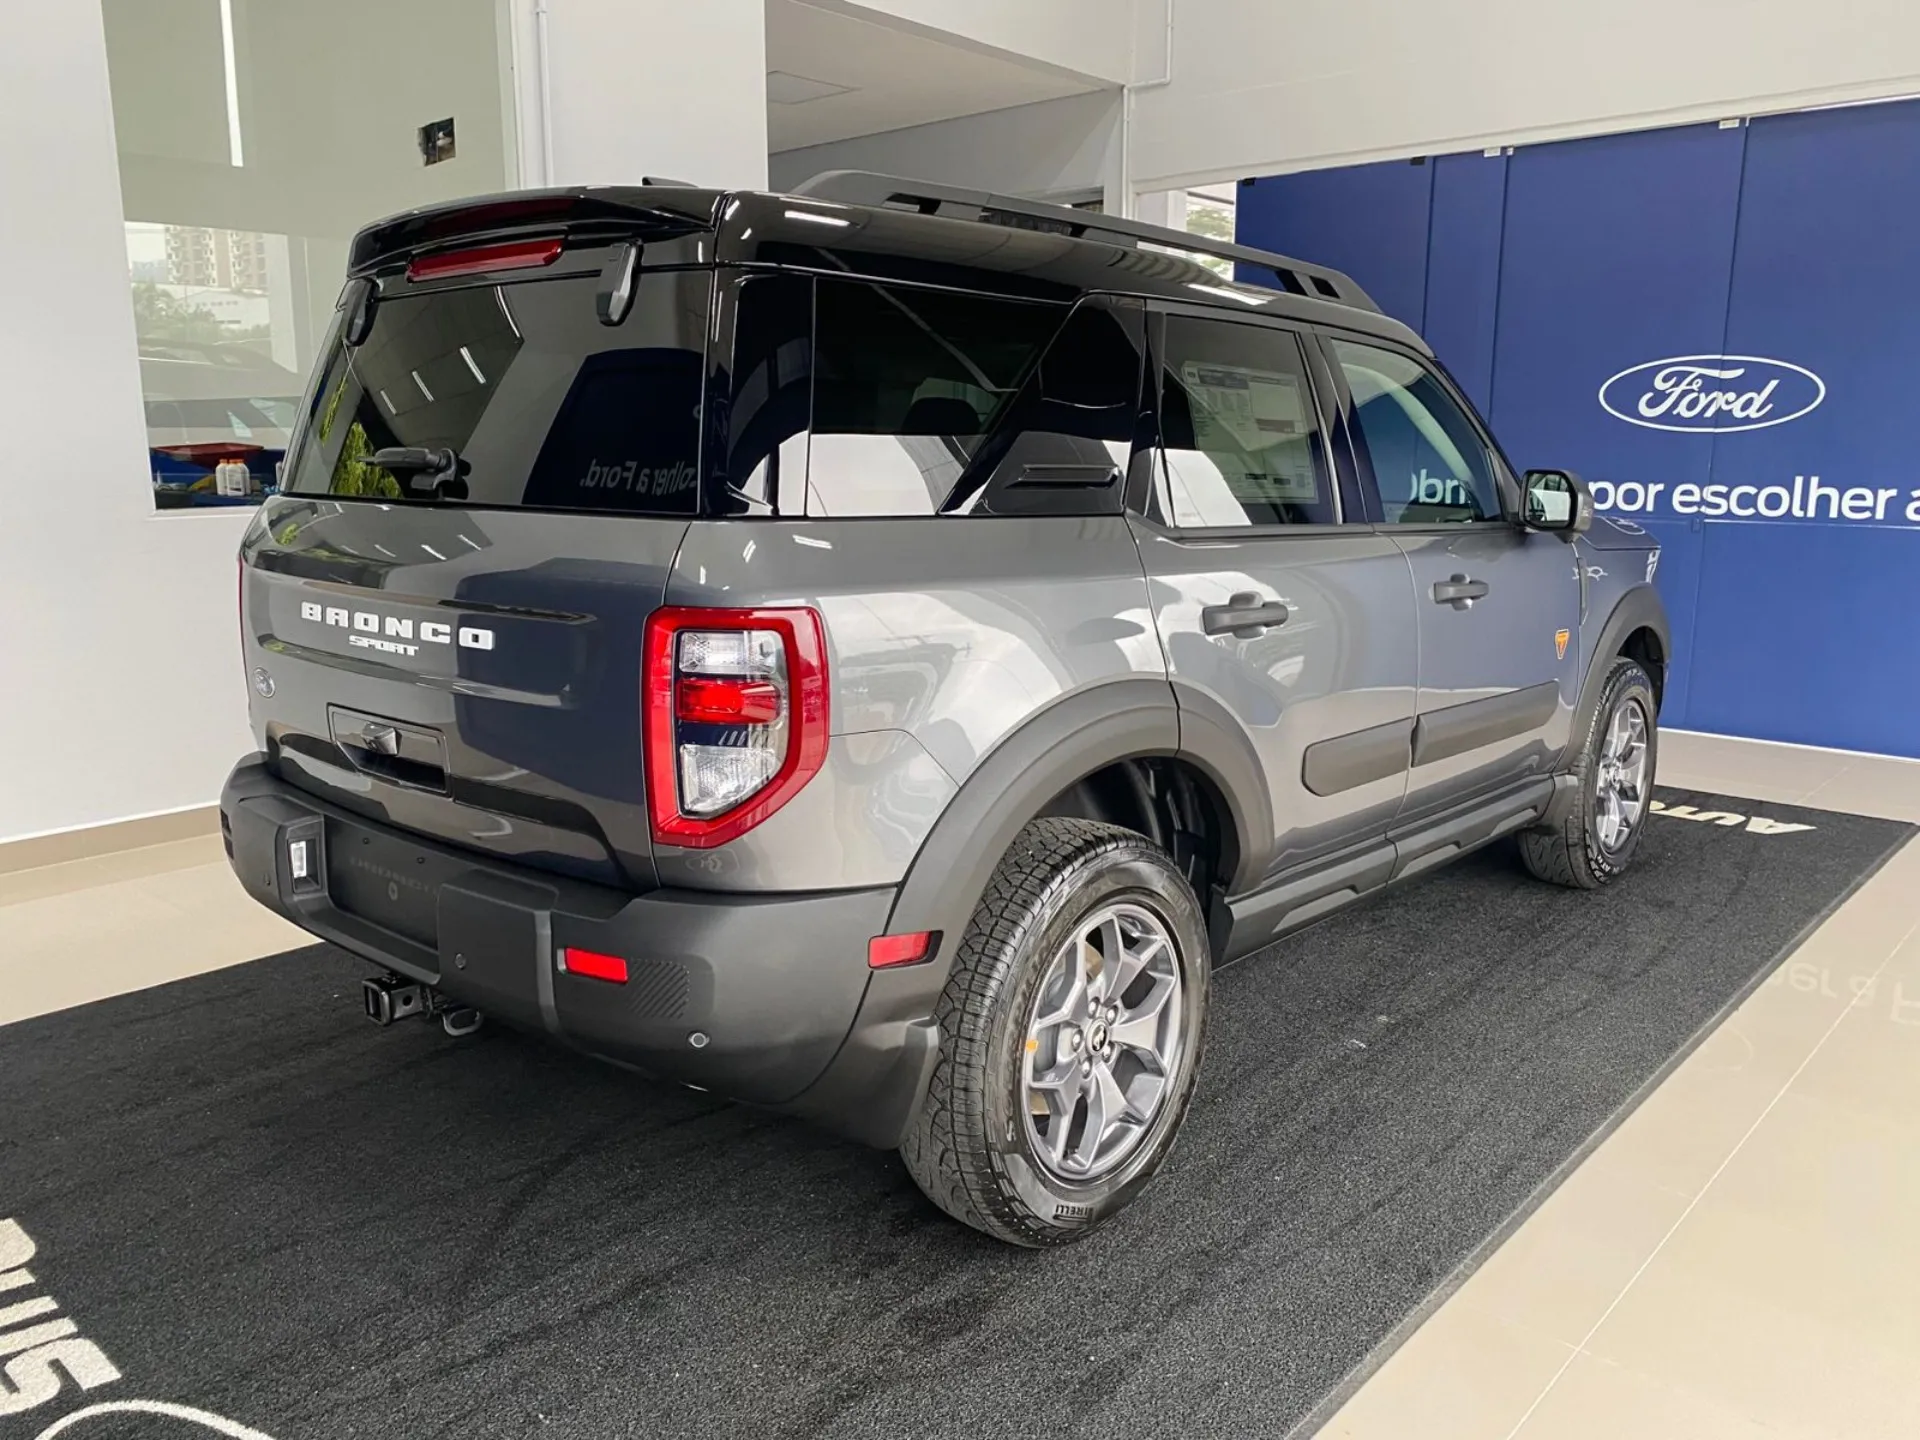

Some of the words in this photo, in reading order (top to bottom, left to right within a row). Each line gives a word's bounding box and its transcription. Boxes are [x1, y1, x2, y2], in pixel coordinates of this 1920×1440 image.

[1638, 365, 1780, 419] Ford
[1588, 480, 1665, 512] por
[1672, 475, 1897, 521] escolher
[301, 601, 495, 651] BRONCO
[349, 634, 419, 656] SPORT
